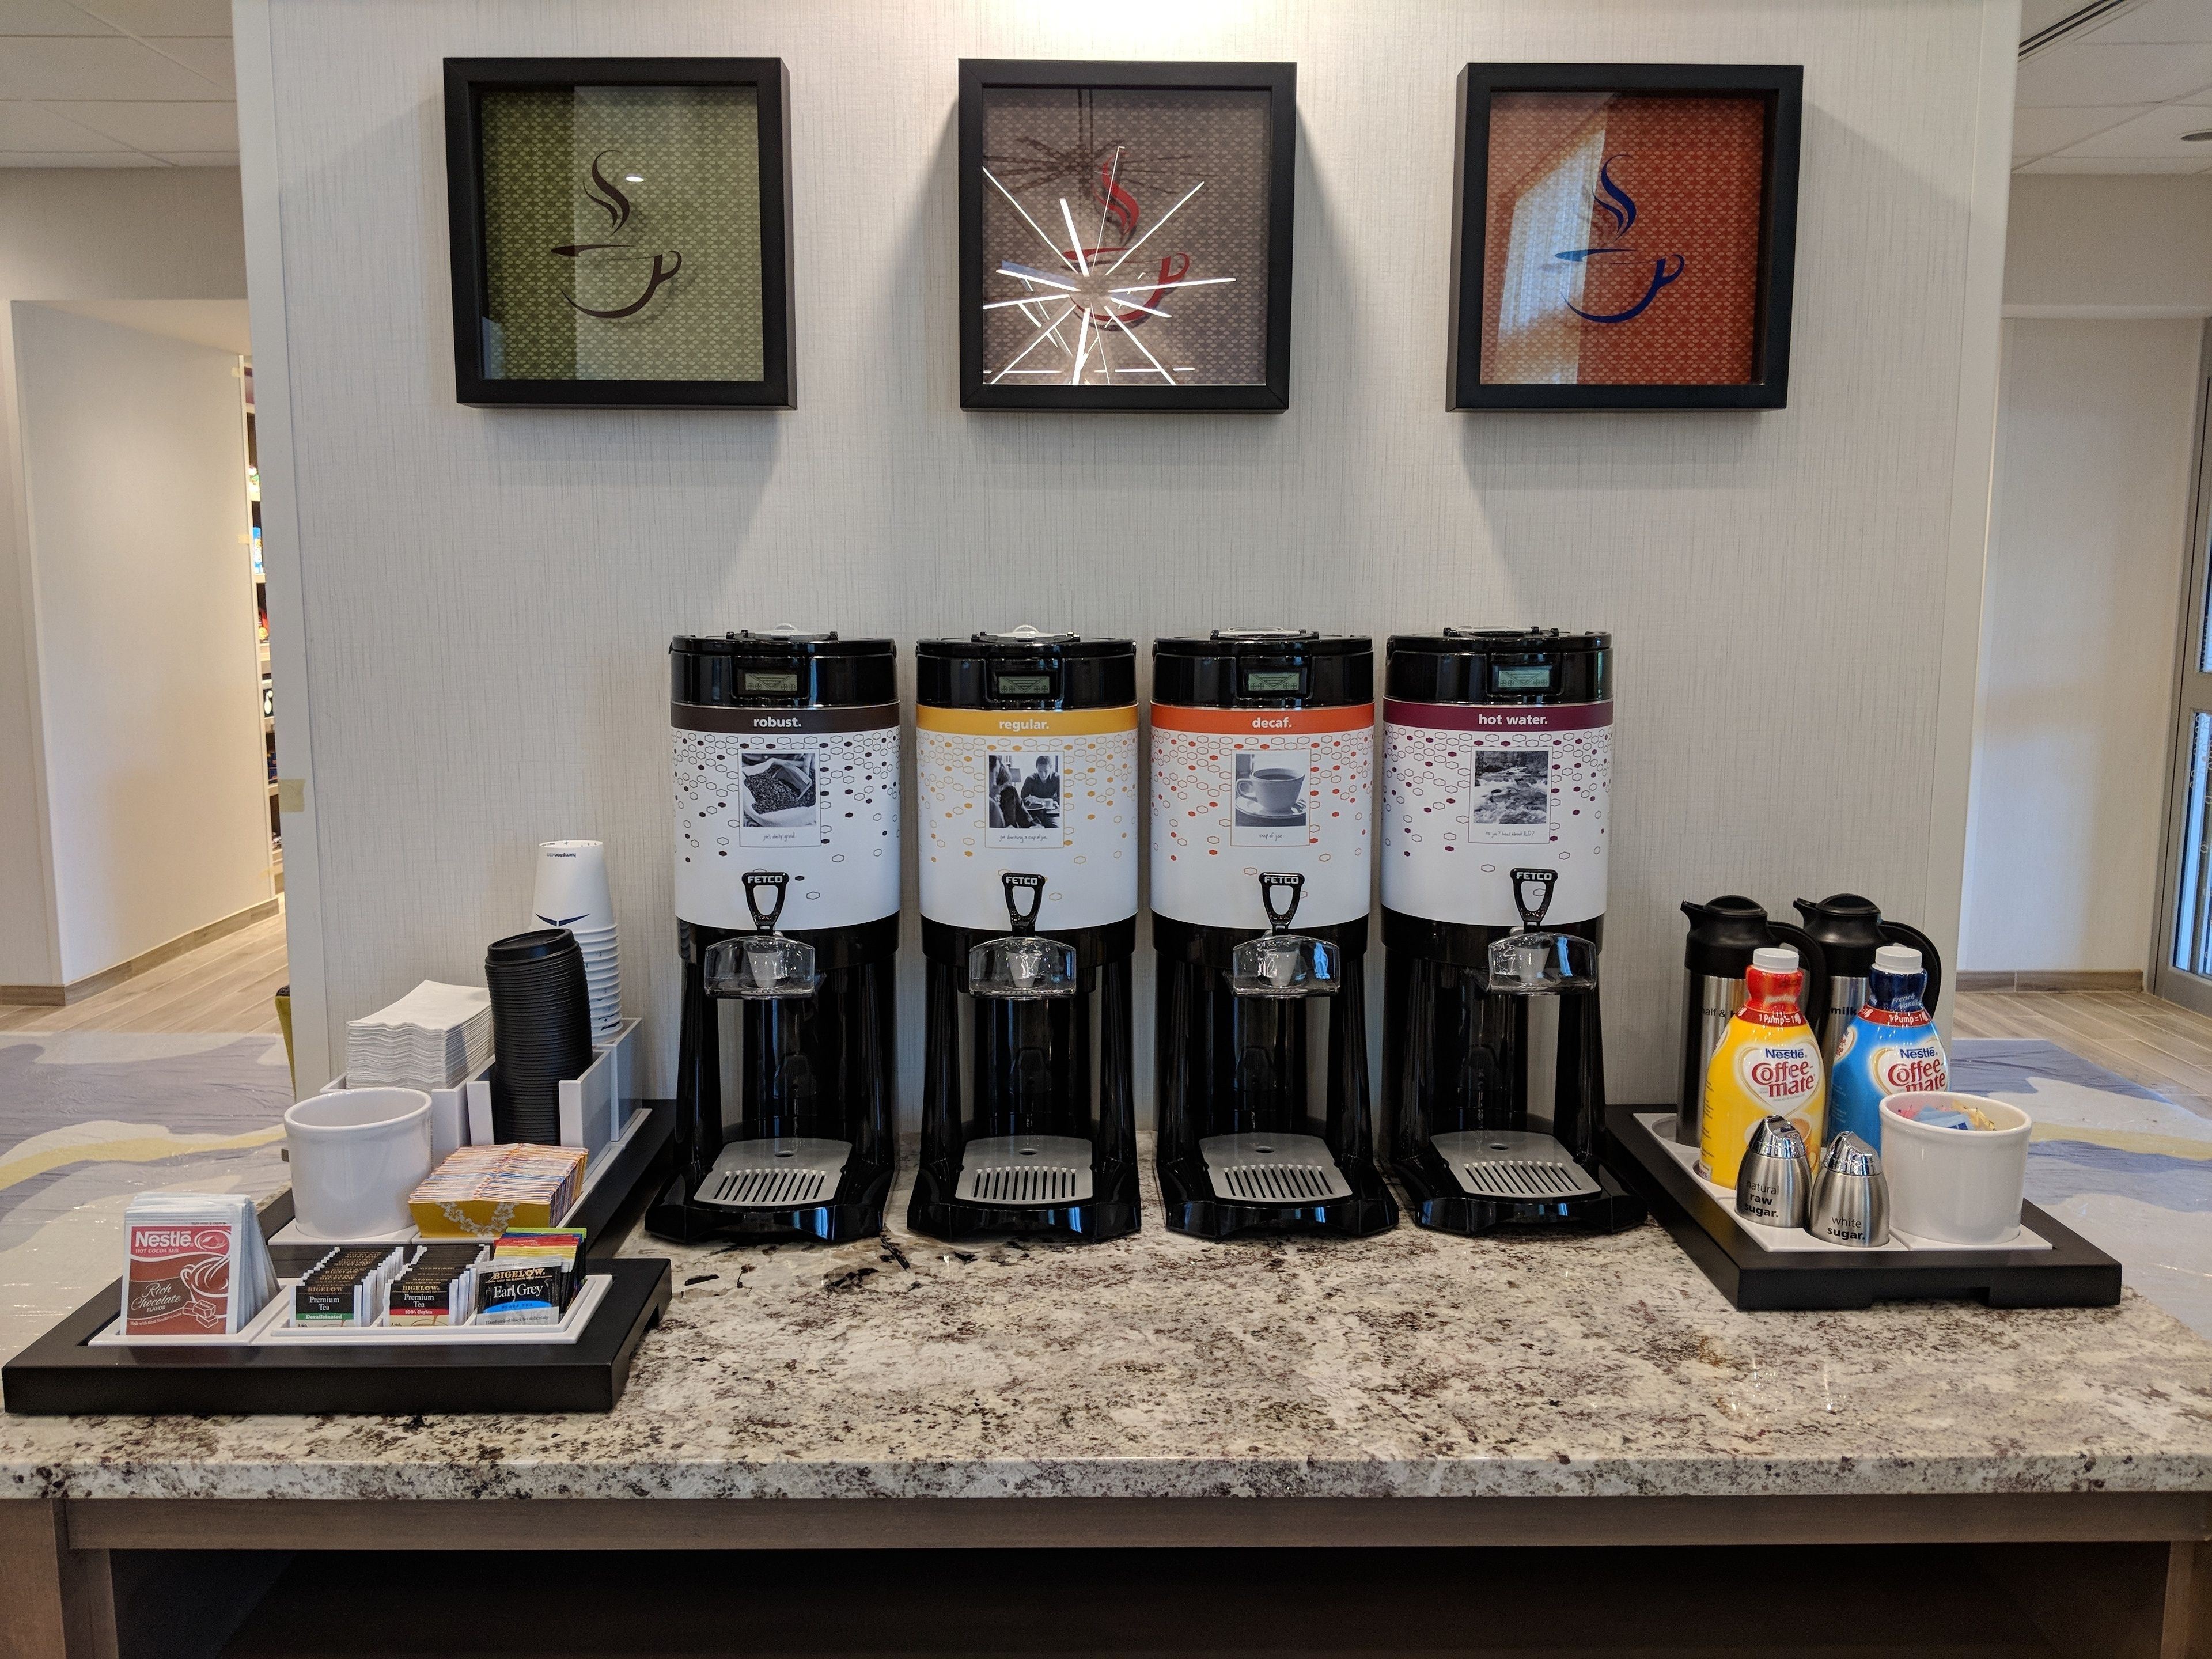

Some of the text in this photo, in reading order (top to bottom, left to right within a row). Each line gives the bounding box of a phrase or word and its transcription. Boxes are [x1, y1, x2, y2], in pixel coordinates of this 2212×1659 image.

[753, 716, 802, 728] robust.
[999, 718, 1050, 732] regular.
[1252, 717, 1292, 728] decaf.
[1478, 713, 1548, 725] hot water.
[747, 875, 783, 884] FETCO
[1006, 876, 1038, 885] FETCO
[1264, 876, 1299, 884] FETCO
[1516, 872, 1552, 881] FETCO
[1892, 993, 1915, 1007] French
[1831, 1006, 1857, 1016] milk
[1763, 1014, 1785, 1026] Pump
[1893, 1014, 1914, 1025] Pump
[1768, 1074, 1815, 1097] mate
[1905, 1072, 1946, 1092] mate
[1746, 1180, 1779, 1195] natural
[1750, 1194, 1773, 1205] raw
[1744, 1203, 1779, 1218] sugar.
[1831, 1216, 1862, 1228] white
[1827, 1228, 1865, 1241] sugar.
[493, 1268, 545, 1280] BIGELOW
[141, 1282, 172, 1298] Rich
[493, 1283, 544, 1298] Earl Grey
[131, 1294, 181, 1311] Chocolate
[309, 1296, 340, 1304] Premium
[146, 1305, 166, 1313] FLAVOR
[318, 1303, 330, 1311] Tea
